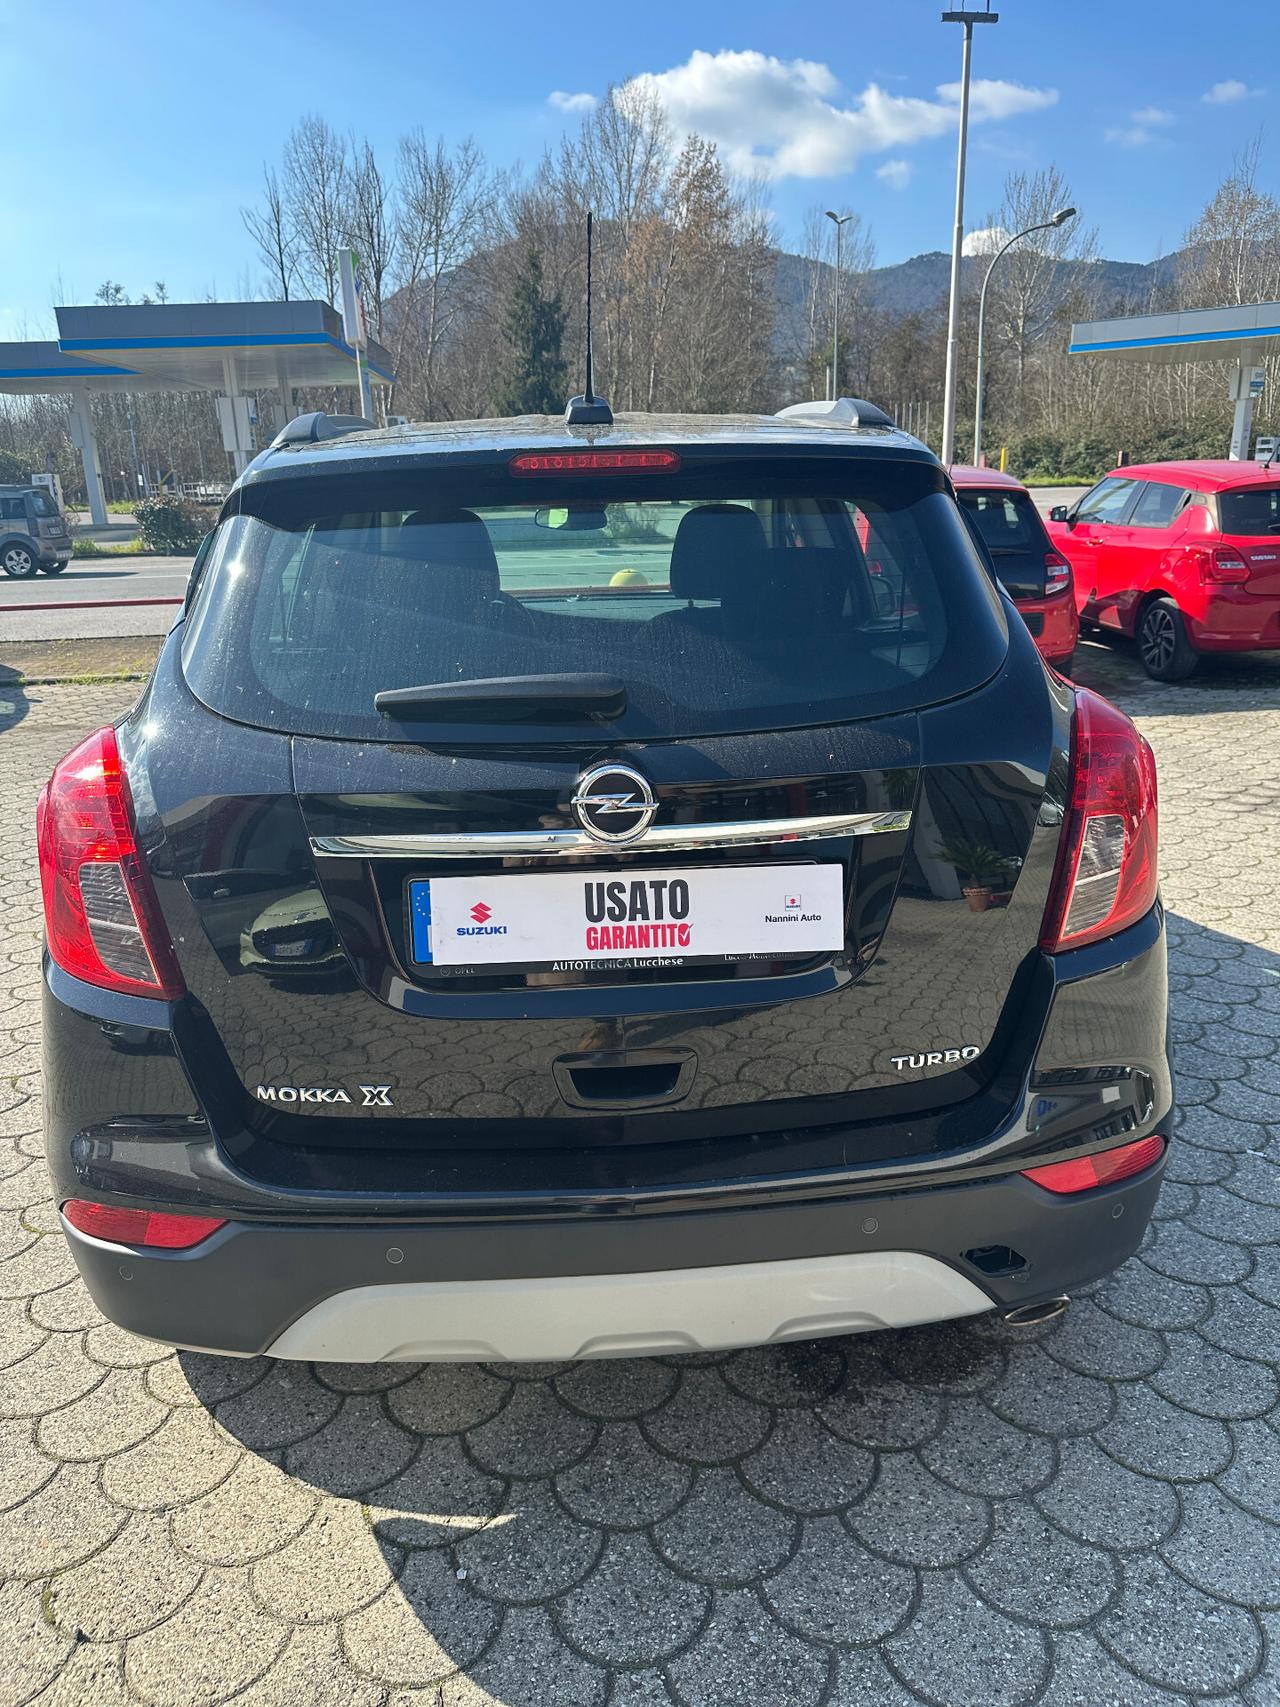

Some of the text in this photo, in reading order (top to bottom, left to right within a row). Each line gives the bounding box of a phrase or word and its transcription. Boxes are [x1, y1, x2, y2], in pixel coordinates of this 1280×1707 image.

[584, 879, 690, 923] USATO
[765, 913, 822, 923] Nannini Auto
[456, 926, 508, 936] SUZUKI
[551, 957, 684, 972] AUTOTECNICA Lucchese
[890, 1045, 980, 1070] TURBO
[257, 1085, 394, 1106] MOKKA X
